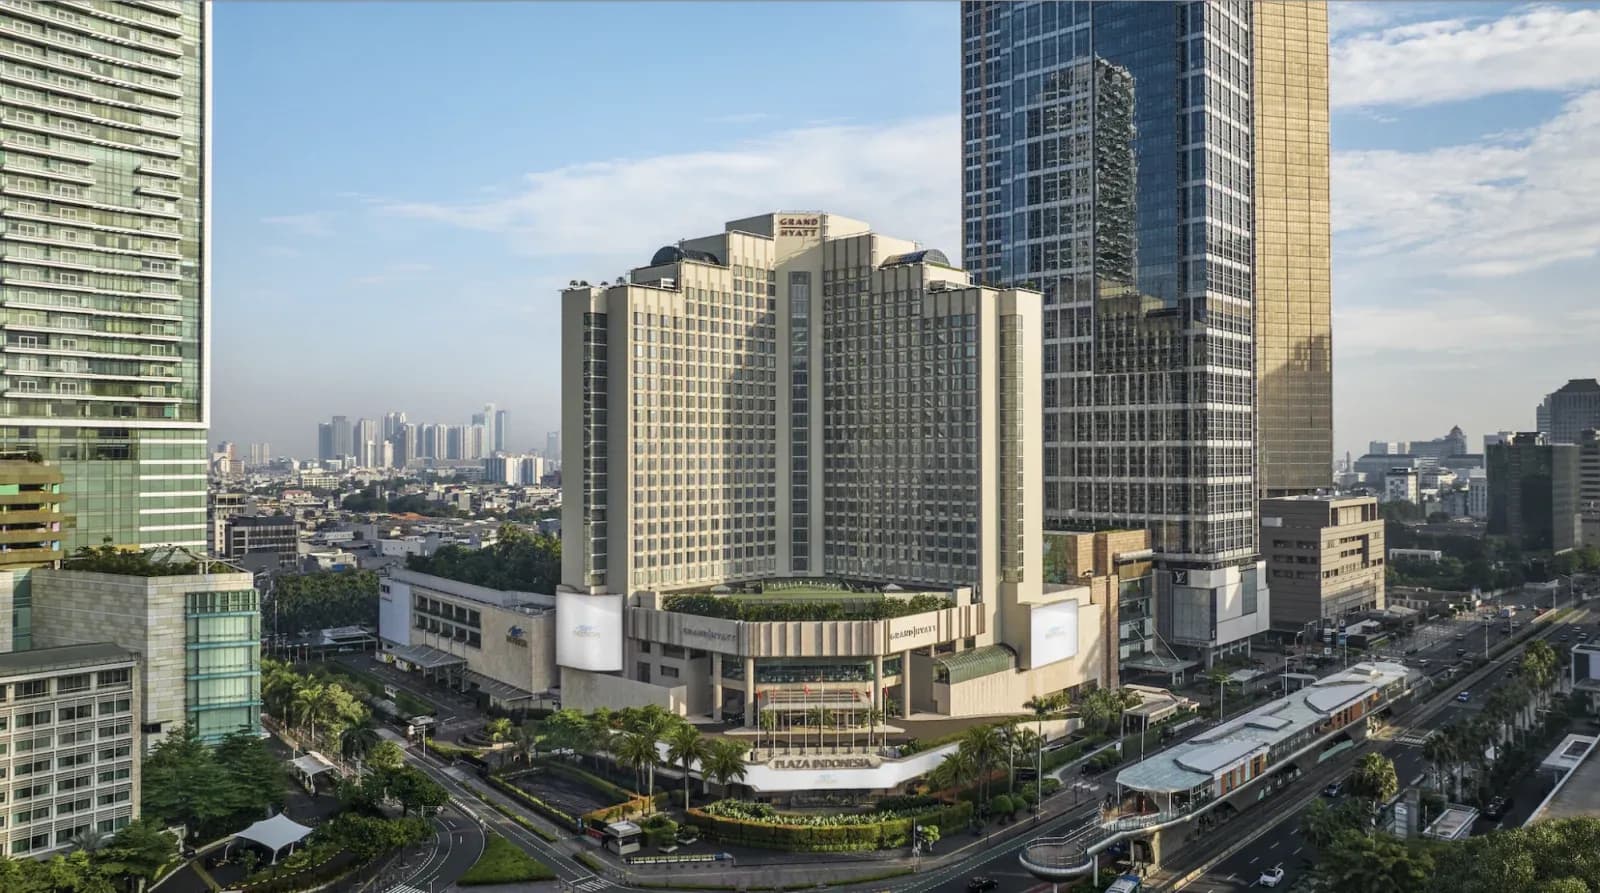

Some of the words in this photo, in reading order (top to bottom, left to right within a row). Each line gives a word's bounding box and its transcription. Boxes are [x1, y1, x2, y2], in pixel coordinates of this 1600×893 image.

[779, 218, 818, 226] GRAND
[780, 229, 817, 237] HYATT
[774, 760, 810, 769] PLAZA
[812, 758, 871, 768] INDONESIA
